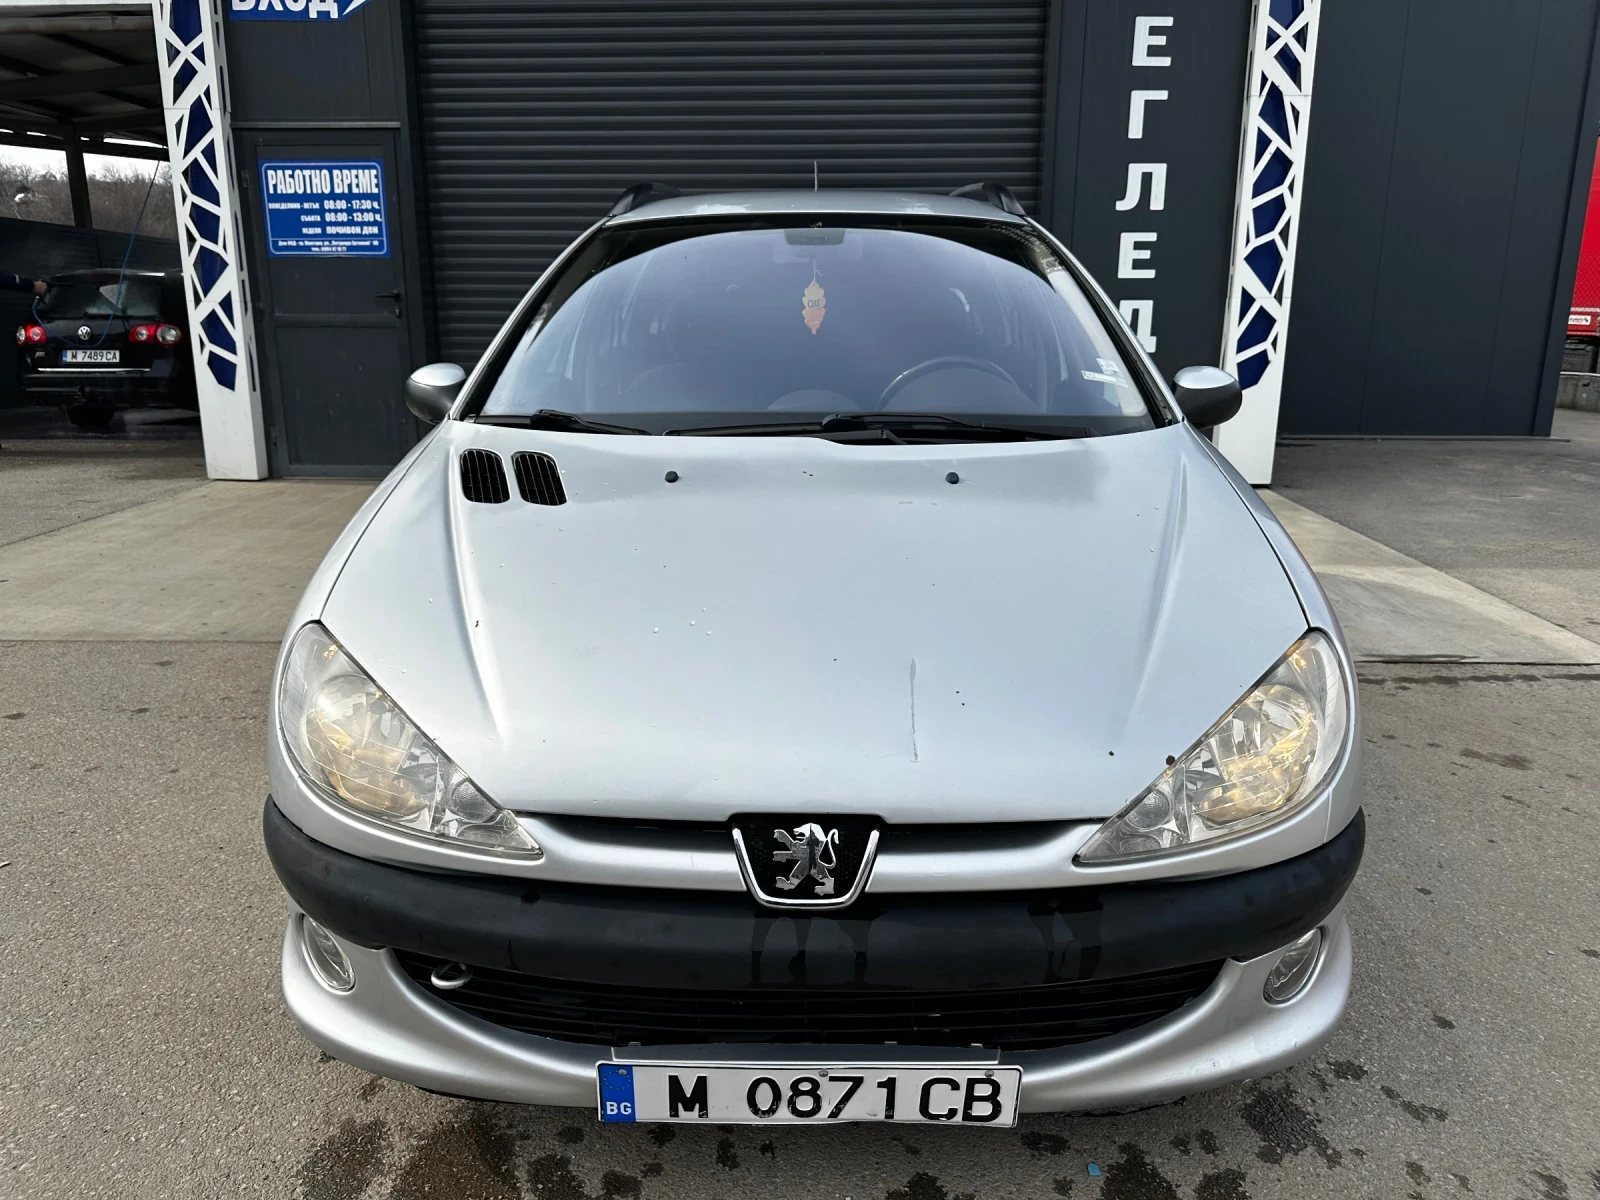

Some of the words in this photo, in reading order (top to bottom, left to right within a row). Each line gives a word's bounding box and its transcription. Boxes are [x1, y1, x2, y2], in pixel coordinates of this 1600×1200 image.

[267, 169, 331, 195] РАБОТНО
[332, 169, 379, 194] ВРЕМЕ
[323, 199, 347, 210] 08:00
[351, 199, 372, 210] 17:30
[325, 212, 348, 222] 08:00
[352, 212, 375, 222] 13:00
[71, 351, 78, 361] M
[81, 351, 104, 361] 7489
[105, 351, 118, 361] CA
[668, 1074, 708, 1118] M
[746, 1075, 897, 1120] 0871
[918, 1076, 1002, 1123] CB
[606, 1101, 632, 1115] BG
